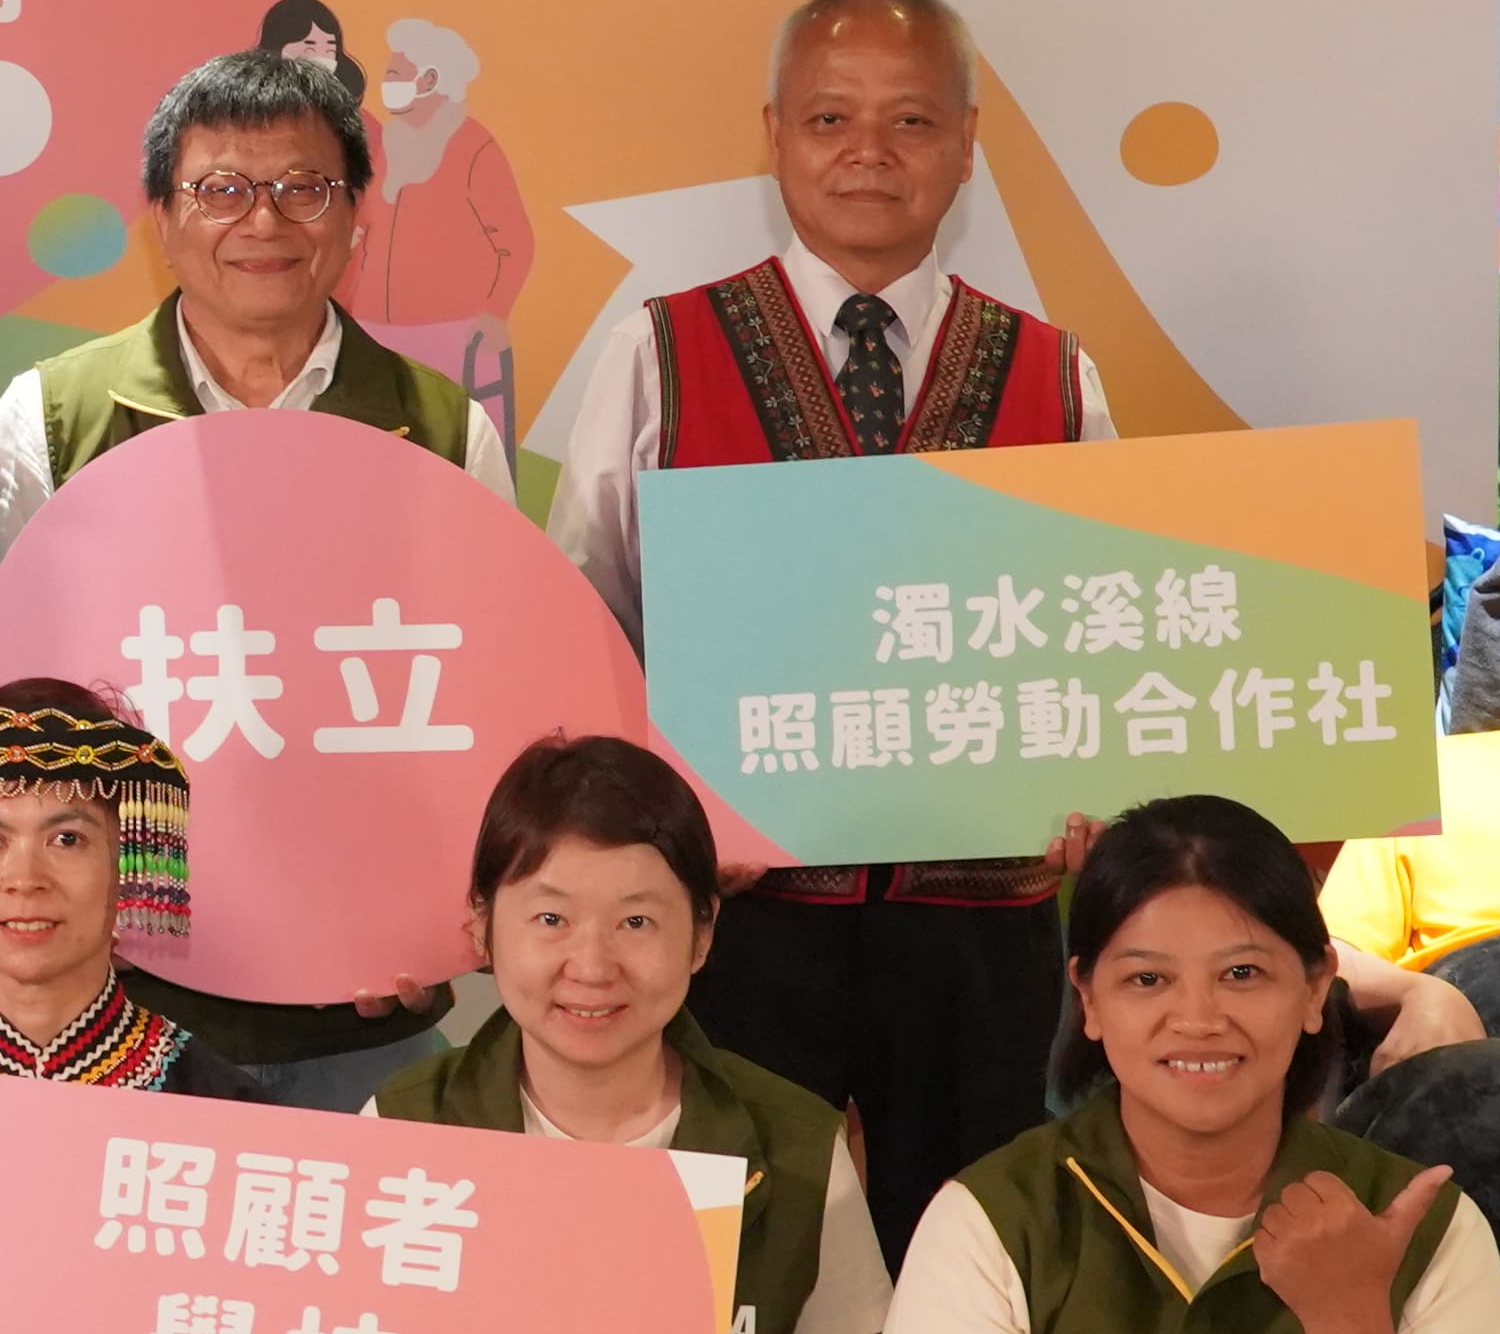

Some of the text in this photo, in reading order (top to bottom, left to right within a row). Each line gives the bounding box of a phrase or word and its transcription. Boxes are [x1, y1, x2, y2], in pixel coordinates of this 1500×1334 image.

[121, 598, 475, 762] 扶立
[872, 564, 1243, 664] 濁水溪線
[738, 660, 1398, 775] 照顧勞動合作社
[94, 1137, 480, 1292] 照顧者
